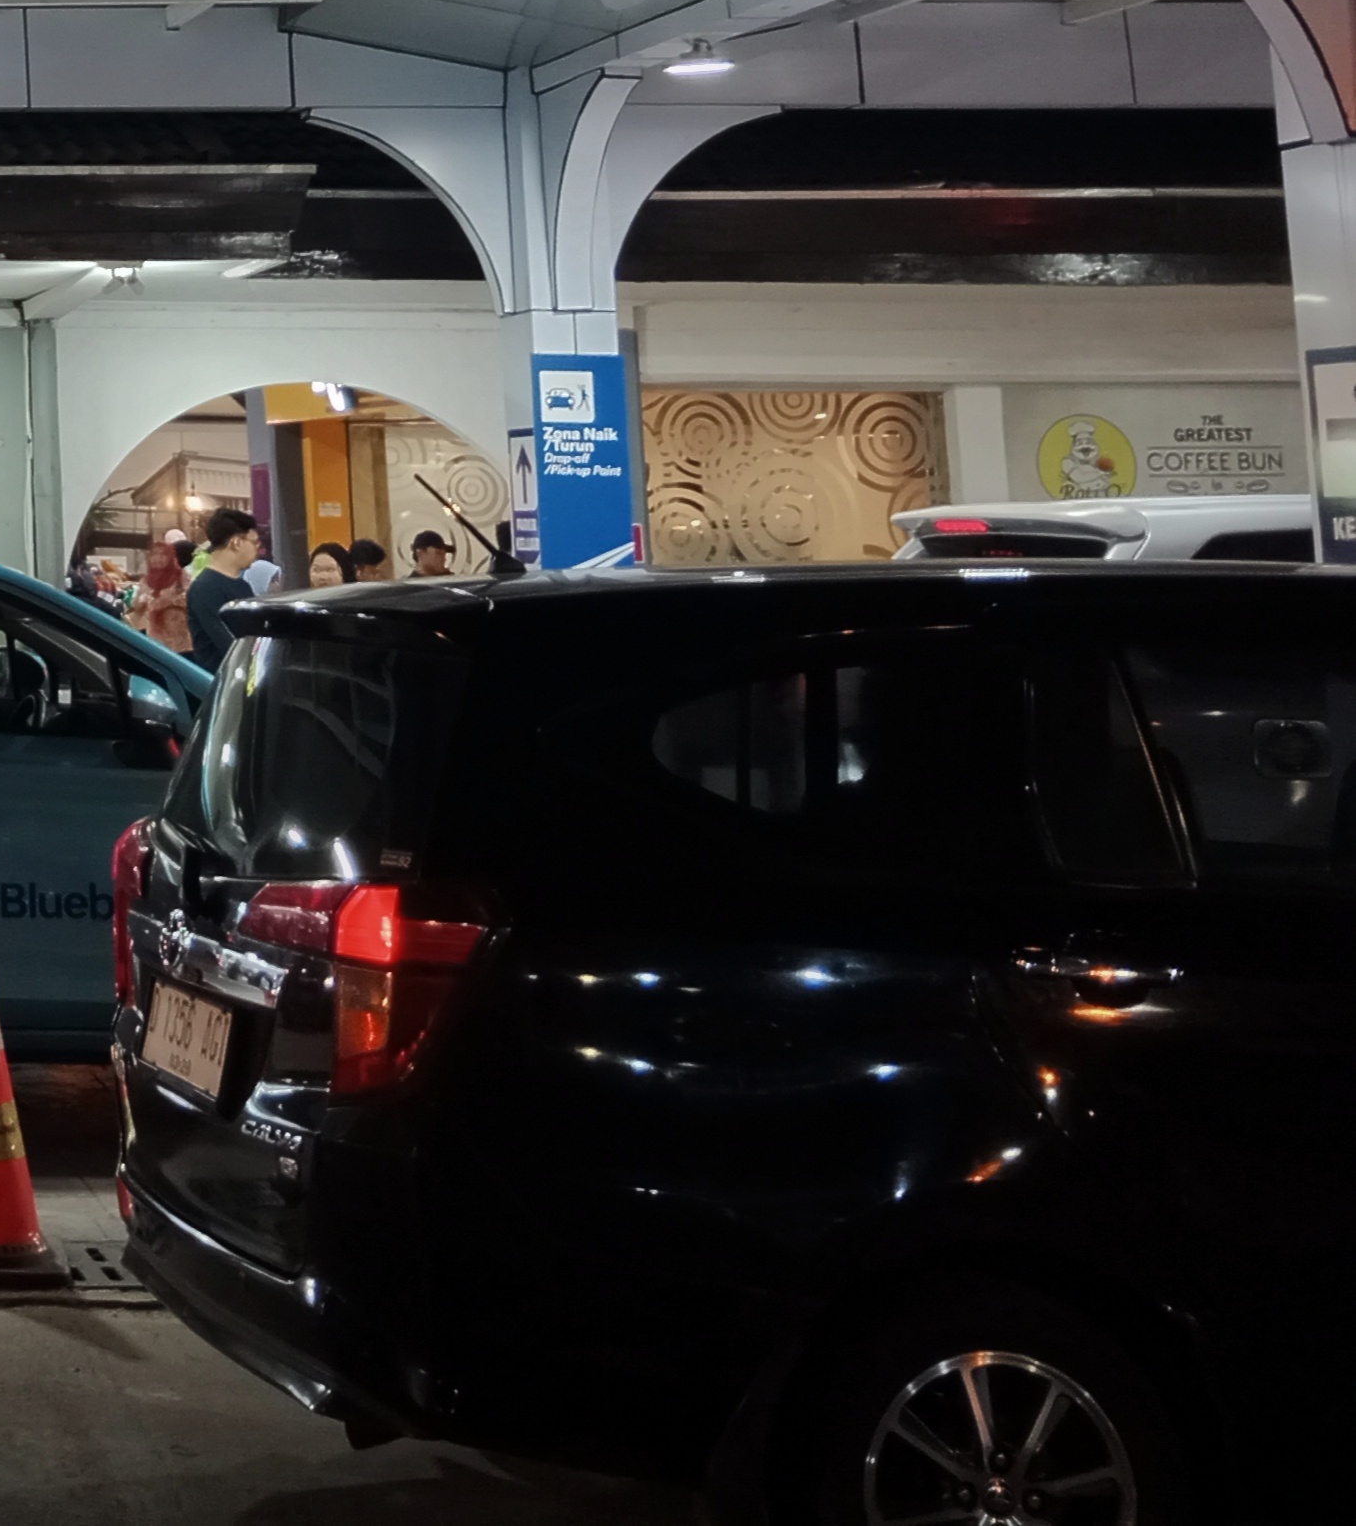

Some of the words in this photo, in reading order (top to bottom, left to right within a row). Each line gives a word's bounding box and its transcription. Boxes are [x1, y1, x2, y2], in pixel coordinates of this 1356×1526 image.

[1200, 415, 1225, 426] THE
[542, 427, 581, 441] Zona
[584, 427, 618, 441] Naik
[1173, 428, 1253, 443] GREATEST
[543, 440, 595, 453] /Turun
[544, 453, 591, 465] Drop-off
[1146, 452, 1230, 472] COFFEE
[1237, 451, 1284, 471] BUN
[544, 465, 591, 478] /Pick-up
[592, 465, 622, 477] Point
[162, 994, 198, 1050] 1356
